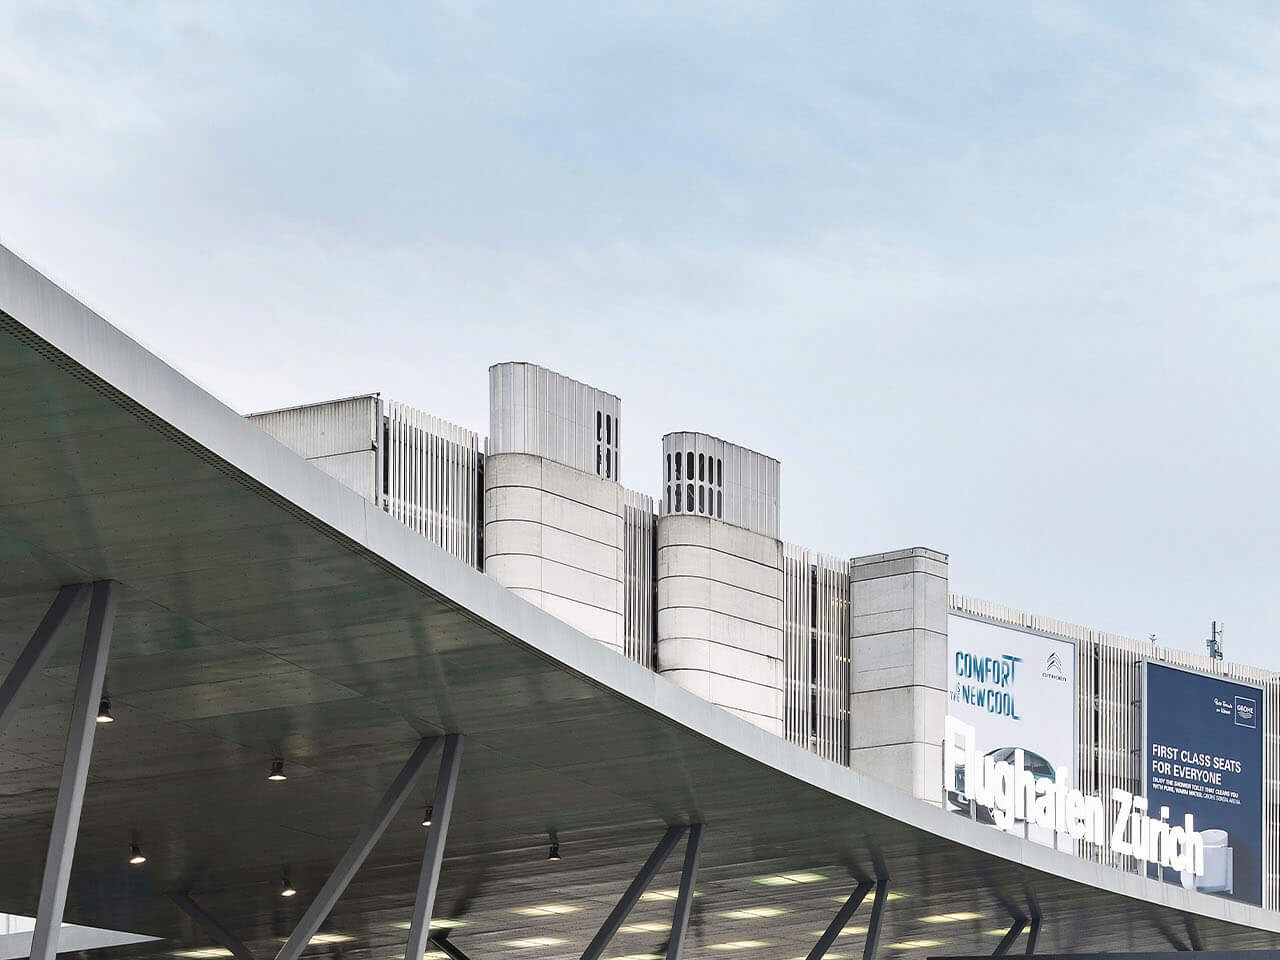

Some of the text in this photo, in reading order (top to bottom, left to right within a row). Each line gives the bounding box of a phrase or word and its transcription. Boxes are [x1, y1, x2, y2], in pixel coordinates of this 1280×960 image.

[955, 651, 1024, 688] COMFORT
[962, 684, 986, 707] NEW
[986, 689, 1022, 721] COOL
[1152, 743, 1242, 774] FIRST CLASS SEATS
[1152, 760, 1222, 786] FOR EVERYONE
[945, 715, 1205, 877] Flughafen Zürich
